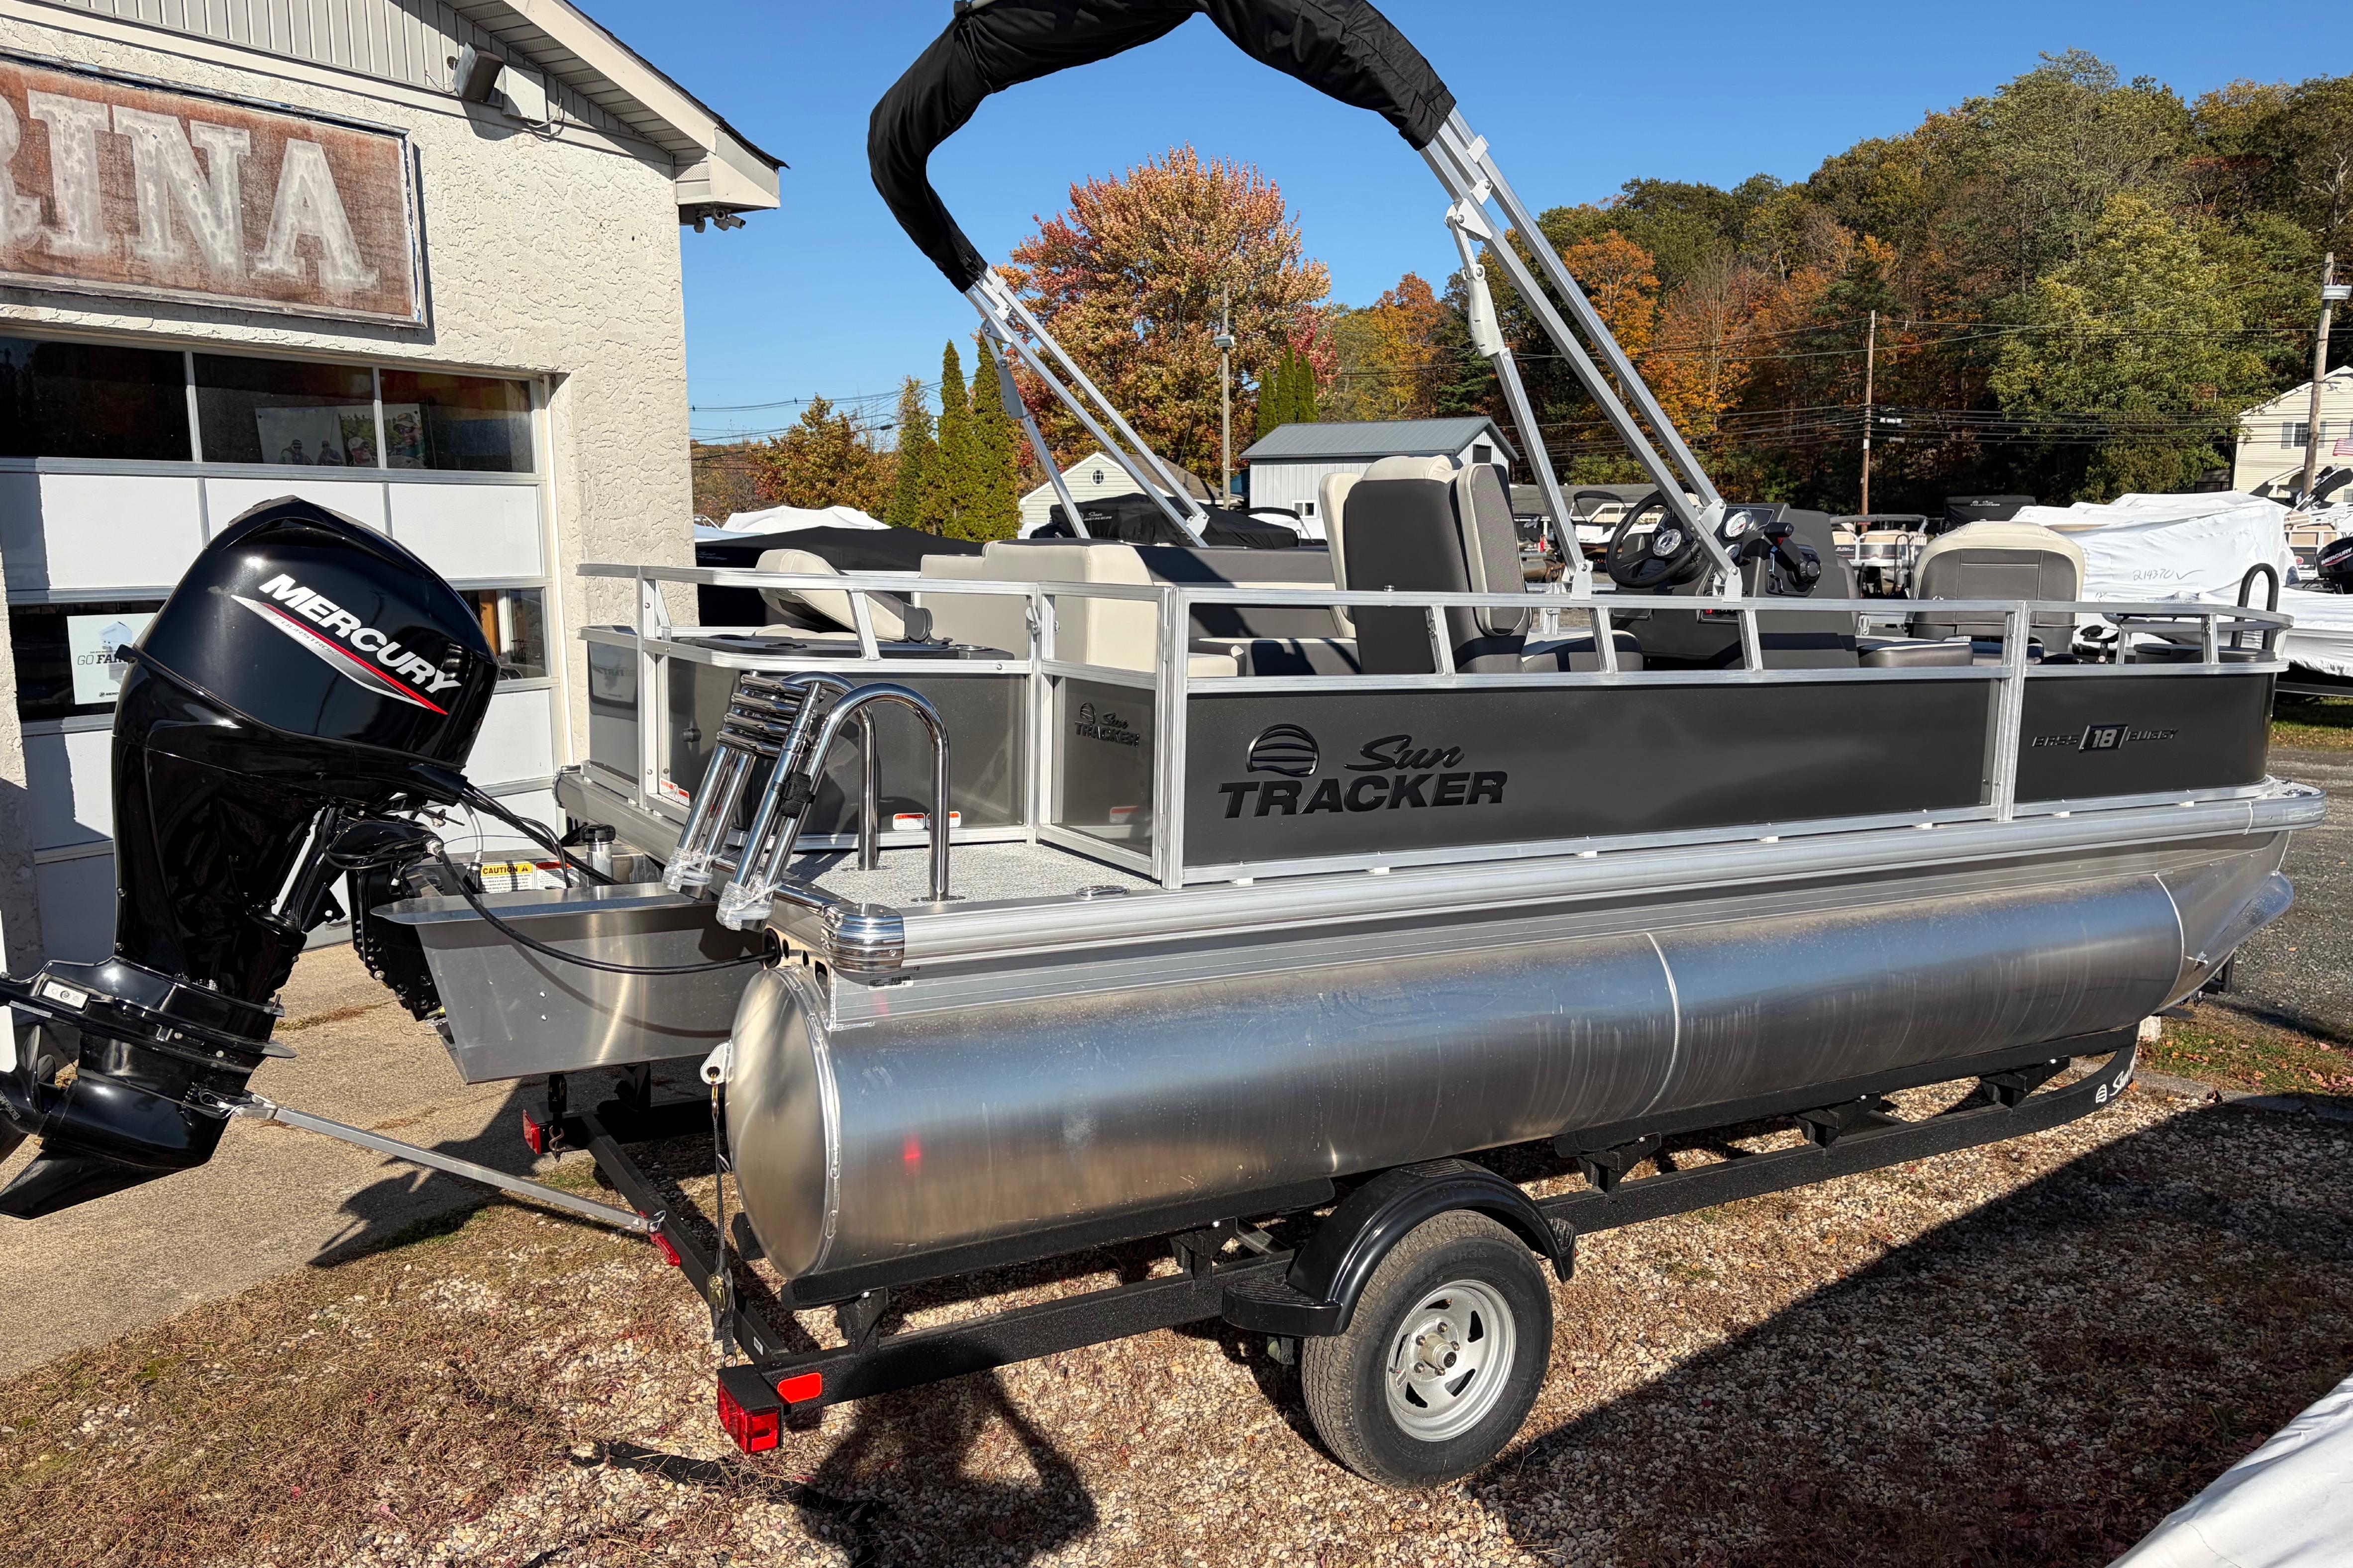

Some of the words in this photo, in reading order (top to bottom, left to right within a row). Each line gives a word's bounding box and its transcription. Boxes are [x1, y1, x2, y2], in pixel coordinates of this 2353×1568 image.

[2321, 547, 2353, 565] MERCURY
[259, 574, 462, 693] MERCURY
[274, 616, 342, 659] FOURSTROKE
[78, 655, 94, 665] GO
[1100, 712, 1128, 729] Sun
[1074, 721, 1140, 747] TRACKER
[2092, 728, 2118, 748] 18
[2126, 729, 2179, 741] BUGGY
[1343, 734, 1464, 771] Sun
[1218, 771, 1508, 819] TRACKER
